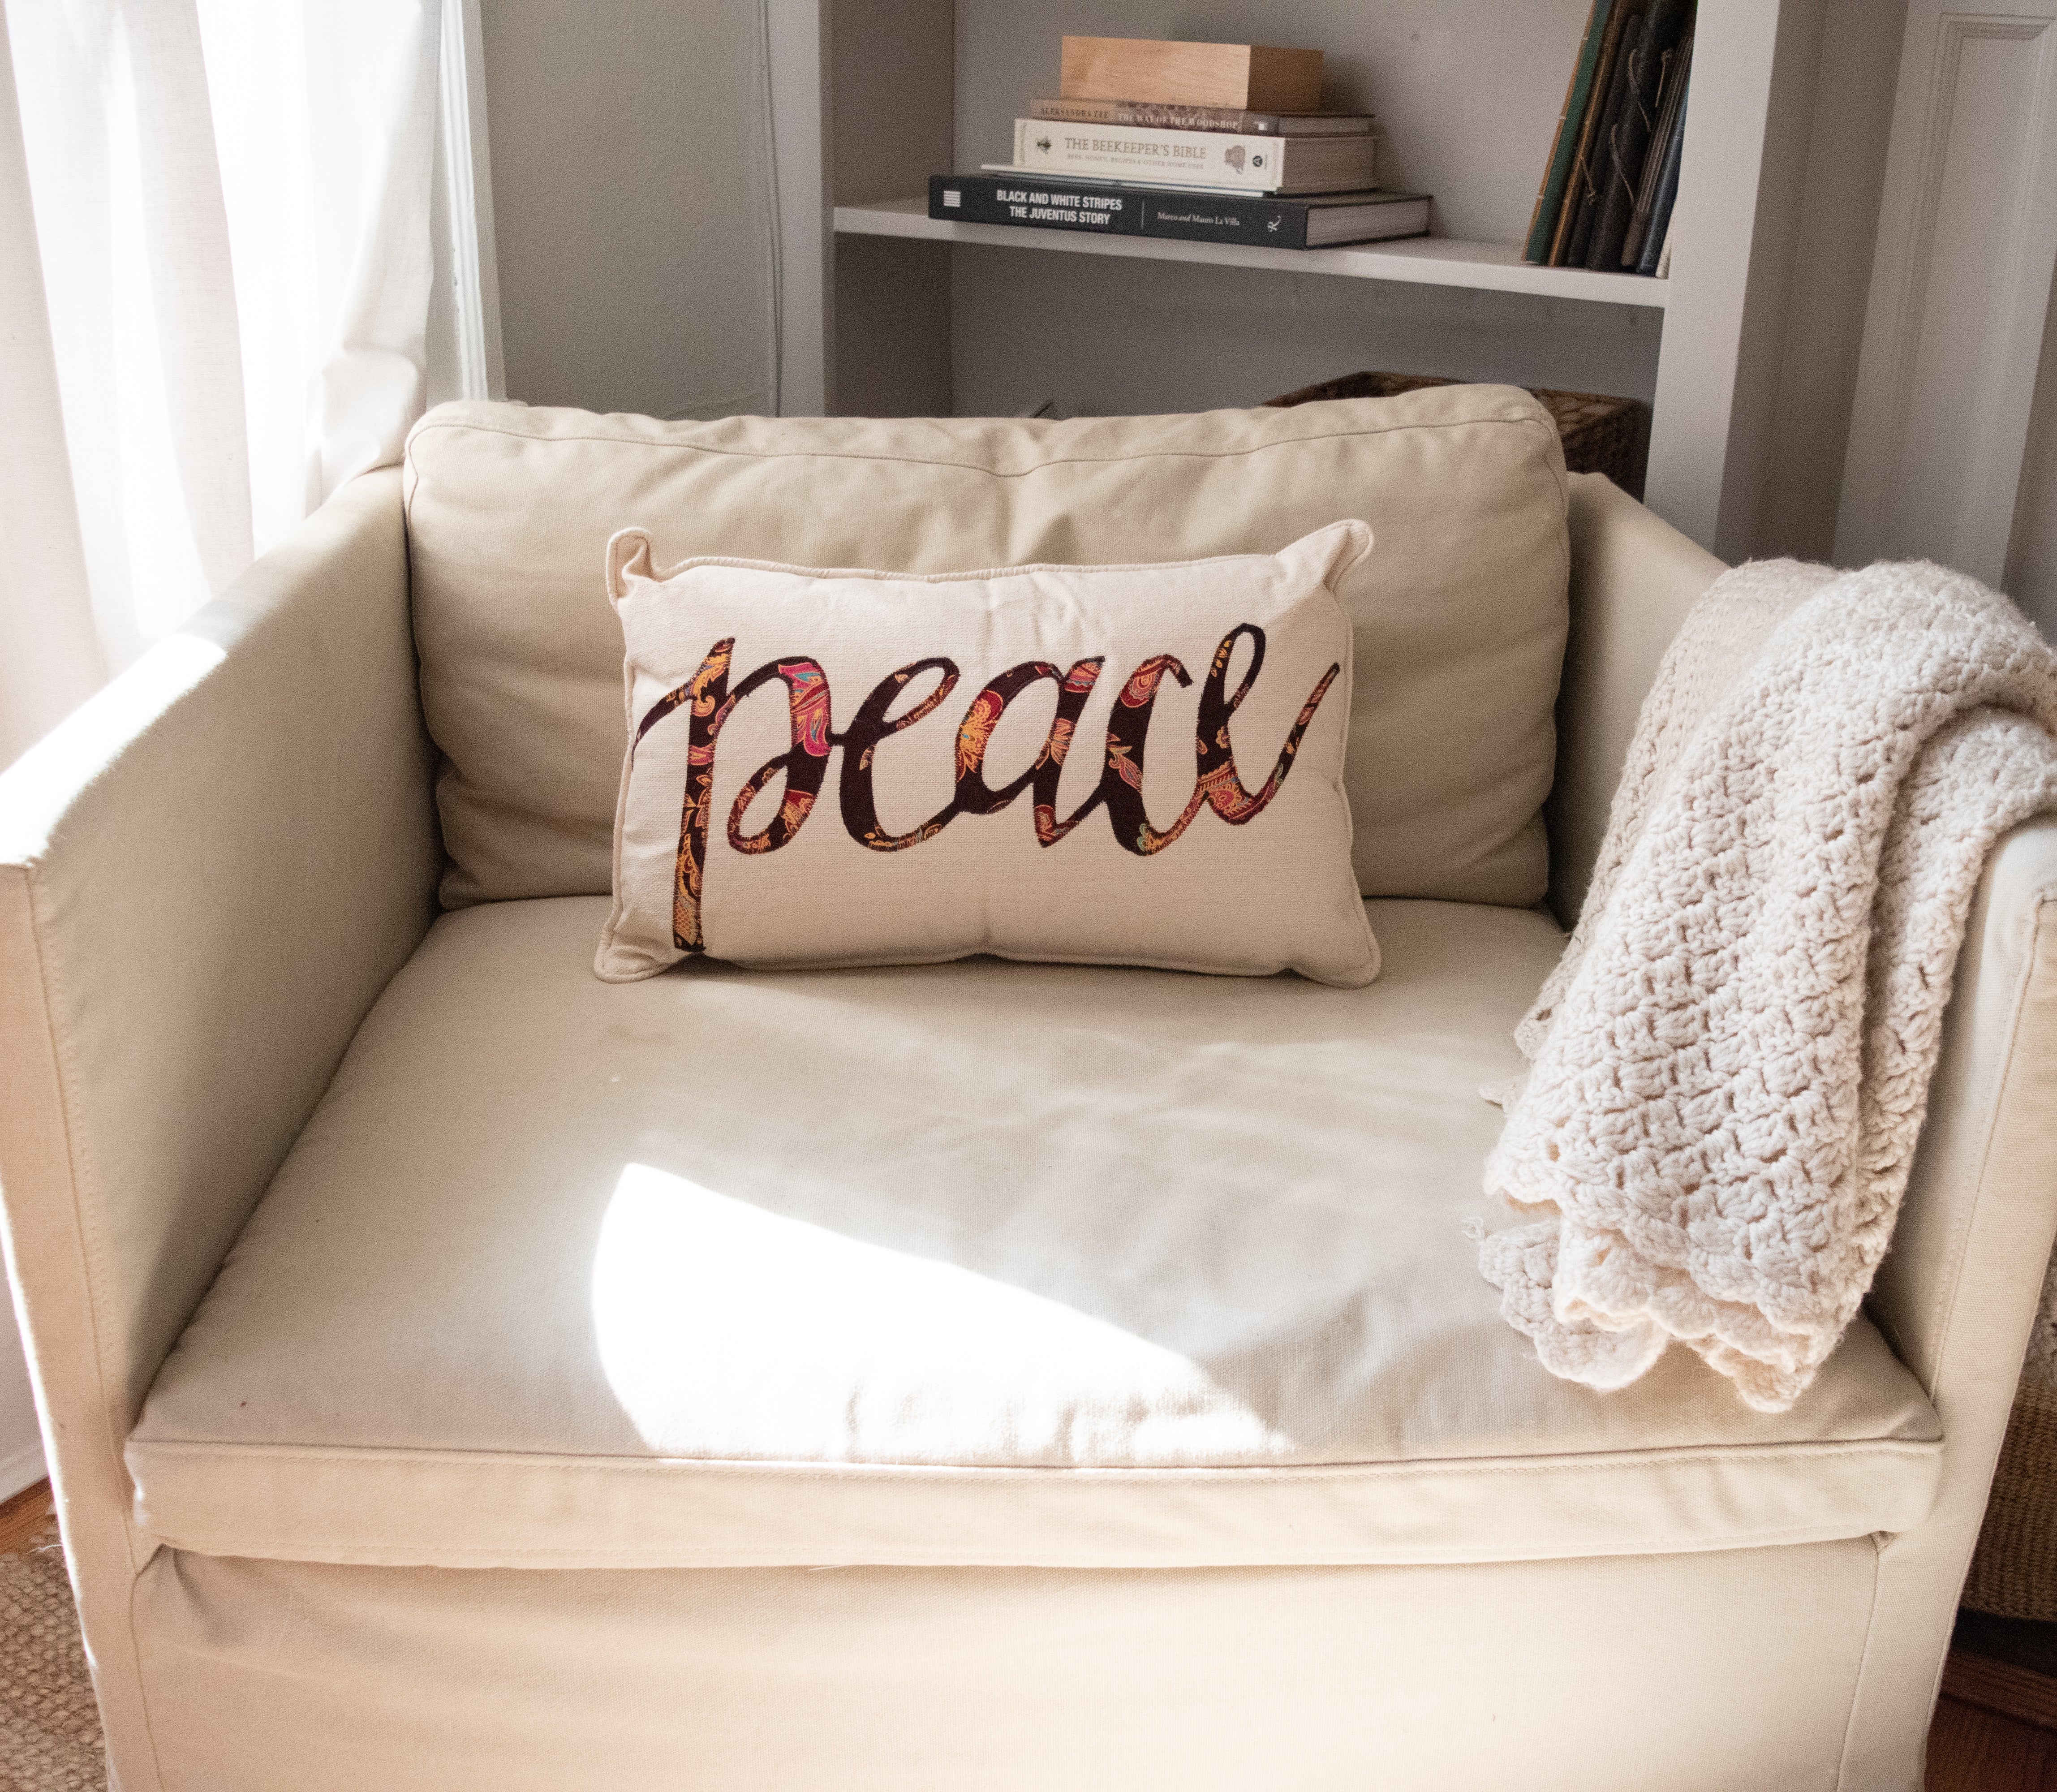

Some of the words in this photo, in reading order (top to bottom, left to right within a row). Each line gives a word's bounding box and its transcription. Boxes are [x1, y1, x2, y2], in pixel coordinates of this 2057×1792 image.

[1118, 113, 1134, 122] THE
[1170, 116, 1186, 125] THE
[1065, 137, 1089, 151] THE
[1092, 139, 1169, 157] BEEKEEPER'S
[1172, 145, 1206, 159] BIBLE
[997, 189, 1027, 202] BLACK
[1029, 192, 1048, 205] AND
[1051, 194, 1080, 207] WHITE
[1082, 196, 1122, 211] STRIPES
[1010, 205, 1027, 218] THE
[1029, 207, 1076, 222] JUVENTUS
[1079, 211, 1110, 224] STORY
[1157, 211, 1178, 220] Marco
[1178, 214, 1192, 222] and
[1192, 215, 1214, 224] Mauro
[1215, 216, 1223, 224] La
[1224, 217, 1239, 226] Villa
[632, 623, 1340, 952] peace
